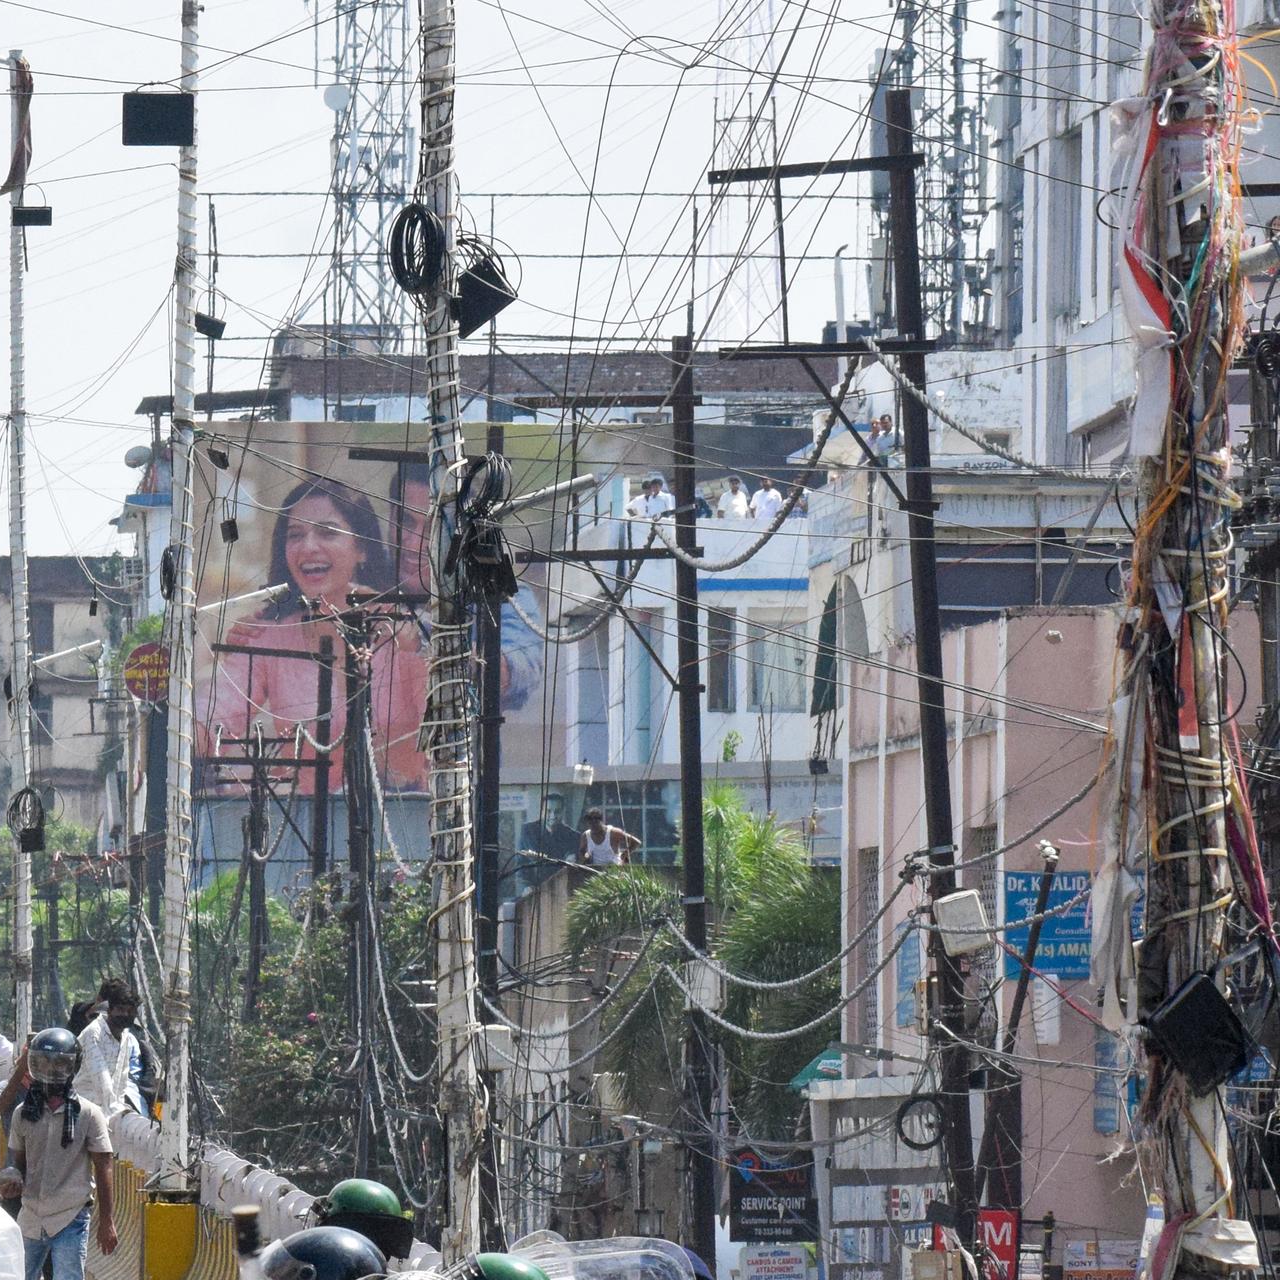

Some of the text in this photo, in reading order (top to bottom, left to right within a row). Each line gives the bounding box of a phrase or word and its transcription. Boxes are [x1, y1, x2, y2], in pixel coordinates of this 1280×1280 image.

[1007, 876, 1086, 892] Dr. KALID
[741, 1197, 778, 1210] SERVICE
